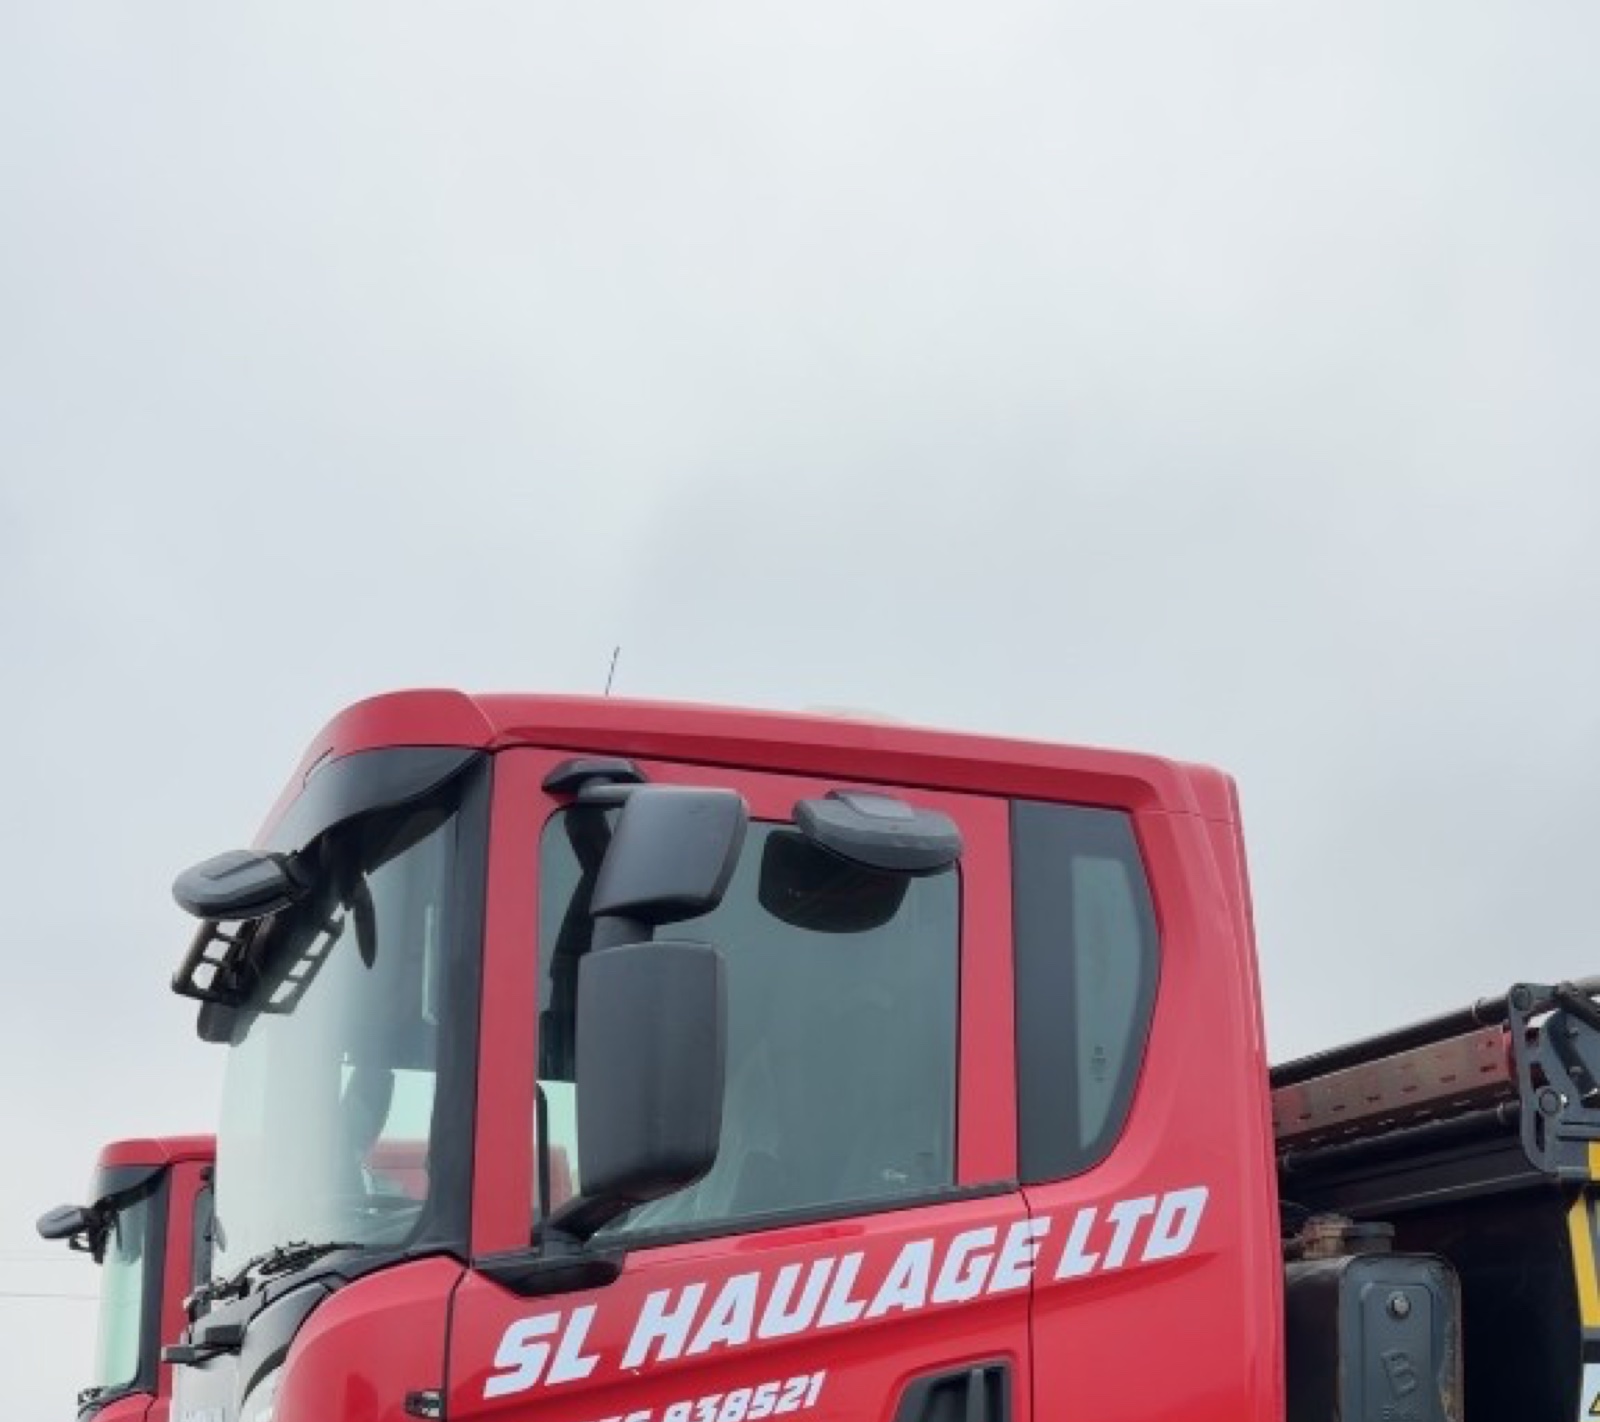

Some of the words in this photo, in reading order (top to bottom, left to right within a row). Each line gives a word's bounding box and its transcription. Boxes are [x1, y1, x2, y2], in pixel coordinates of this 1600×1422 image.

[484, 1305, 600, 1398] SL
[620, 1216, 1052, 1369] HAULAGE
[1055, 1186, 1209, 1280] LTD
